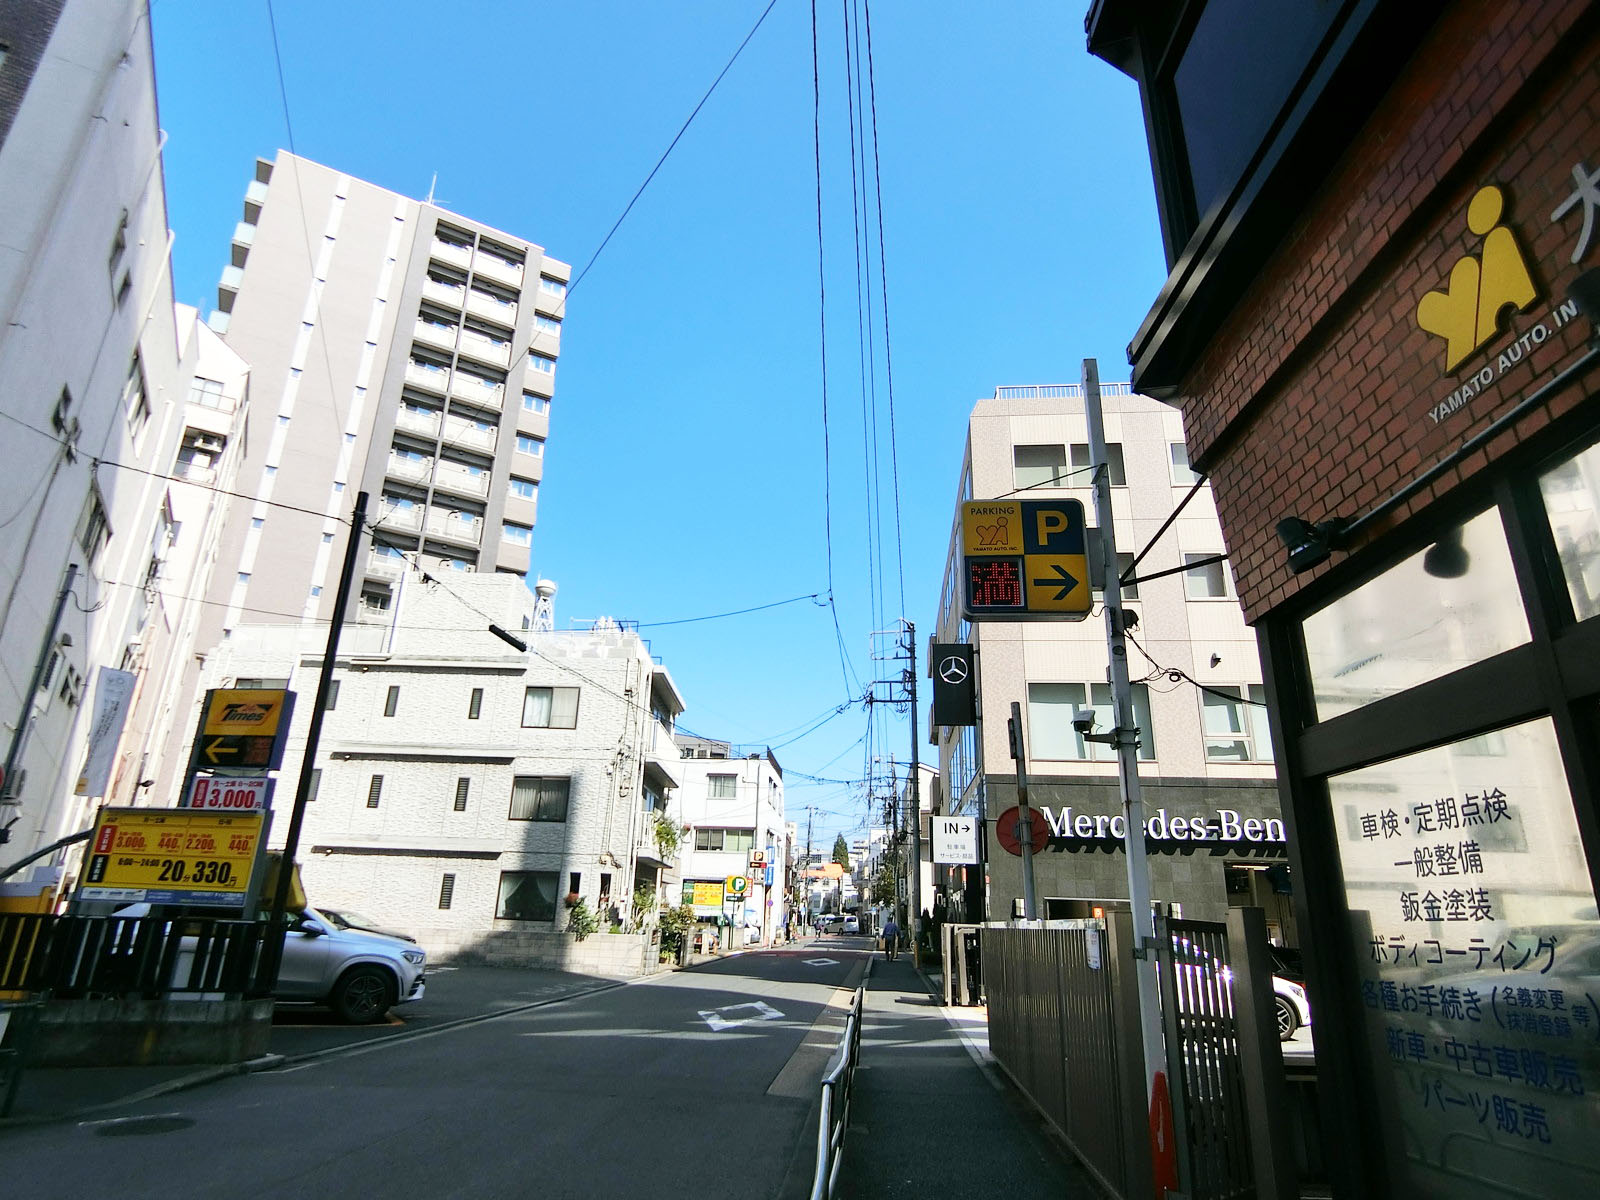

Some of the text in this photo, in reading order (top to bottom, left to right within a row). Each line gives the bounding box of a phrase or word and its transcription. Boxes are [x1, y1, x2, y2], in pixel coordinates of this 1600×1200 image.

[1428, 367, 1494, 424] YAMATO
[1497, 322, 1552, 374] AUTO.
[970, 506, 1015, 516] PARKING
[1036, 510, 1069, 546] P
[972, 562, 1020, 605] 満
[221, 707, 266, 722] Times
[944, 822, 958, 834] IN
[1360, 787, 1512, 841] 車検・定期点検
[1394, 840, 1484, 878] 一般整備
[735, 878, 745, 890] P
[1400, 888, 1495, 922] 鈑金塗装
[1368, 935, 1558, 974] ボディコーティング
[1385, 1026, 1585, 1096] 新車・中古車販売
[1424, 1078, 1552, 1144] パーツ販売
